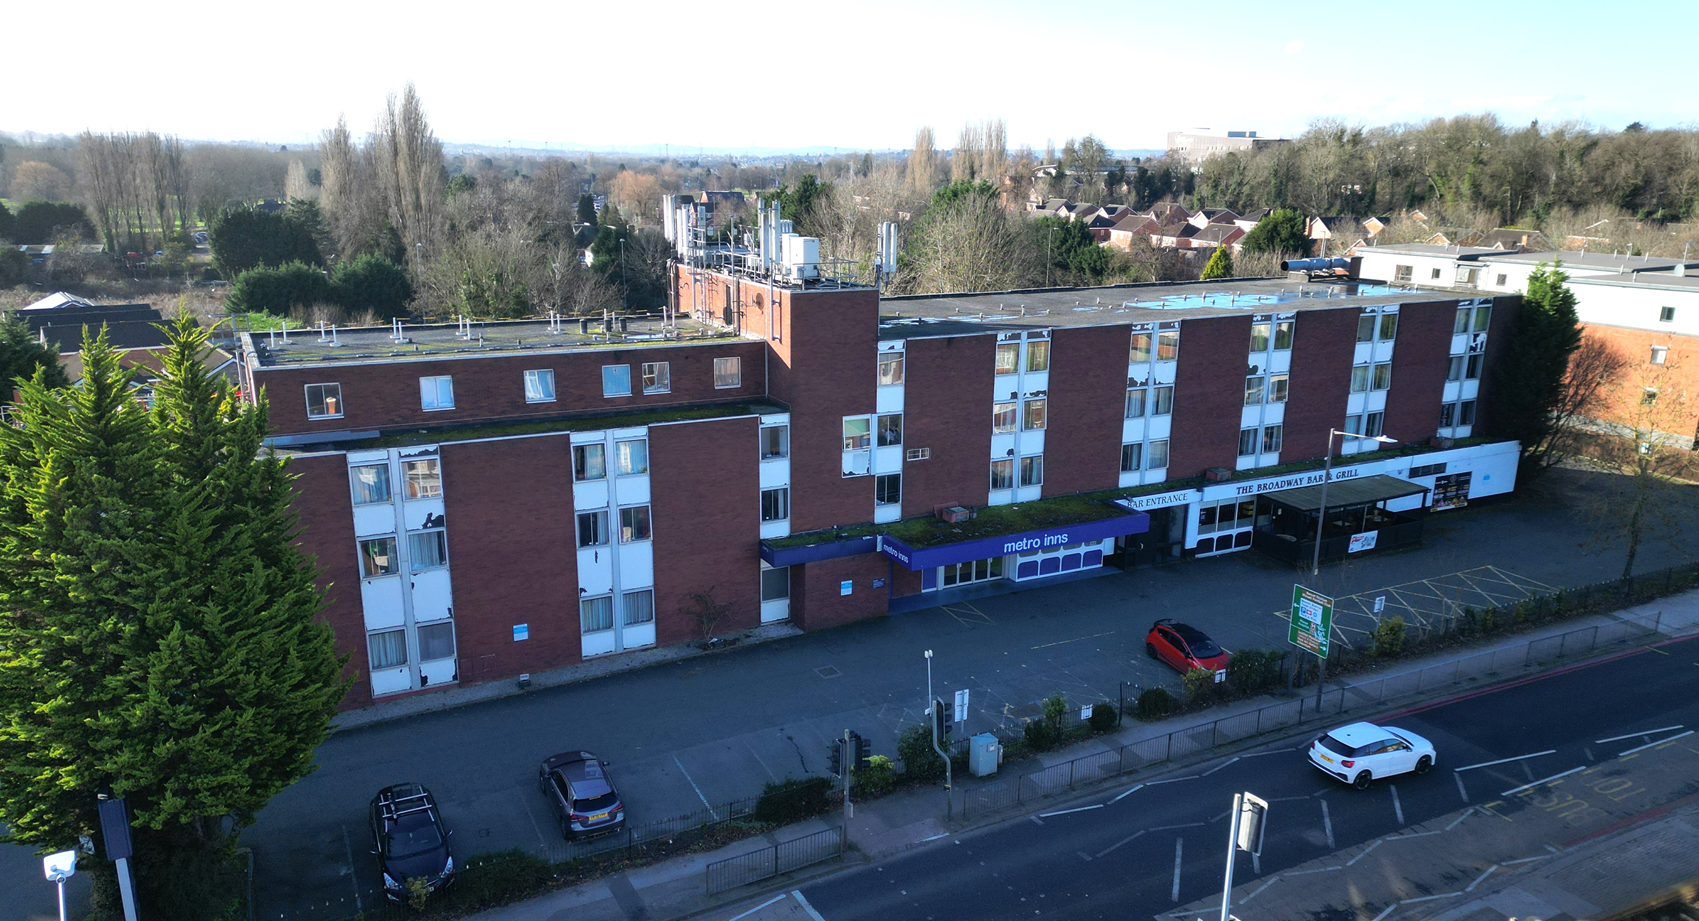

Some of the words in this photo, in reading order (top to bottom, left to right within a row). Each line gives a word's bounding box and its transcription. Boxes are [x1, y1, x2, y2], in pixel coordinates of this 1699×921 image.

[1236, 484, 1254, 495] THE
[1256, 477, 1304, 492] BROADWAY
[1307, 474, 1324, 485] BAR
[1335, 468, 1359, 480] GRILL
[1145, 492, 1188, 507] ENTRANCE
[1003, 537, 1041, 553] metro
[1044, 533, 1069, 546] inns
[883, 544, 898, 557] metro
[898, 551, 909, 564] inns
